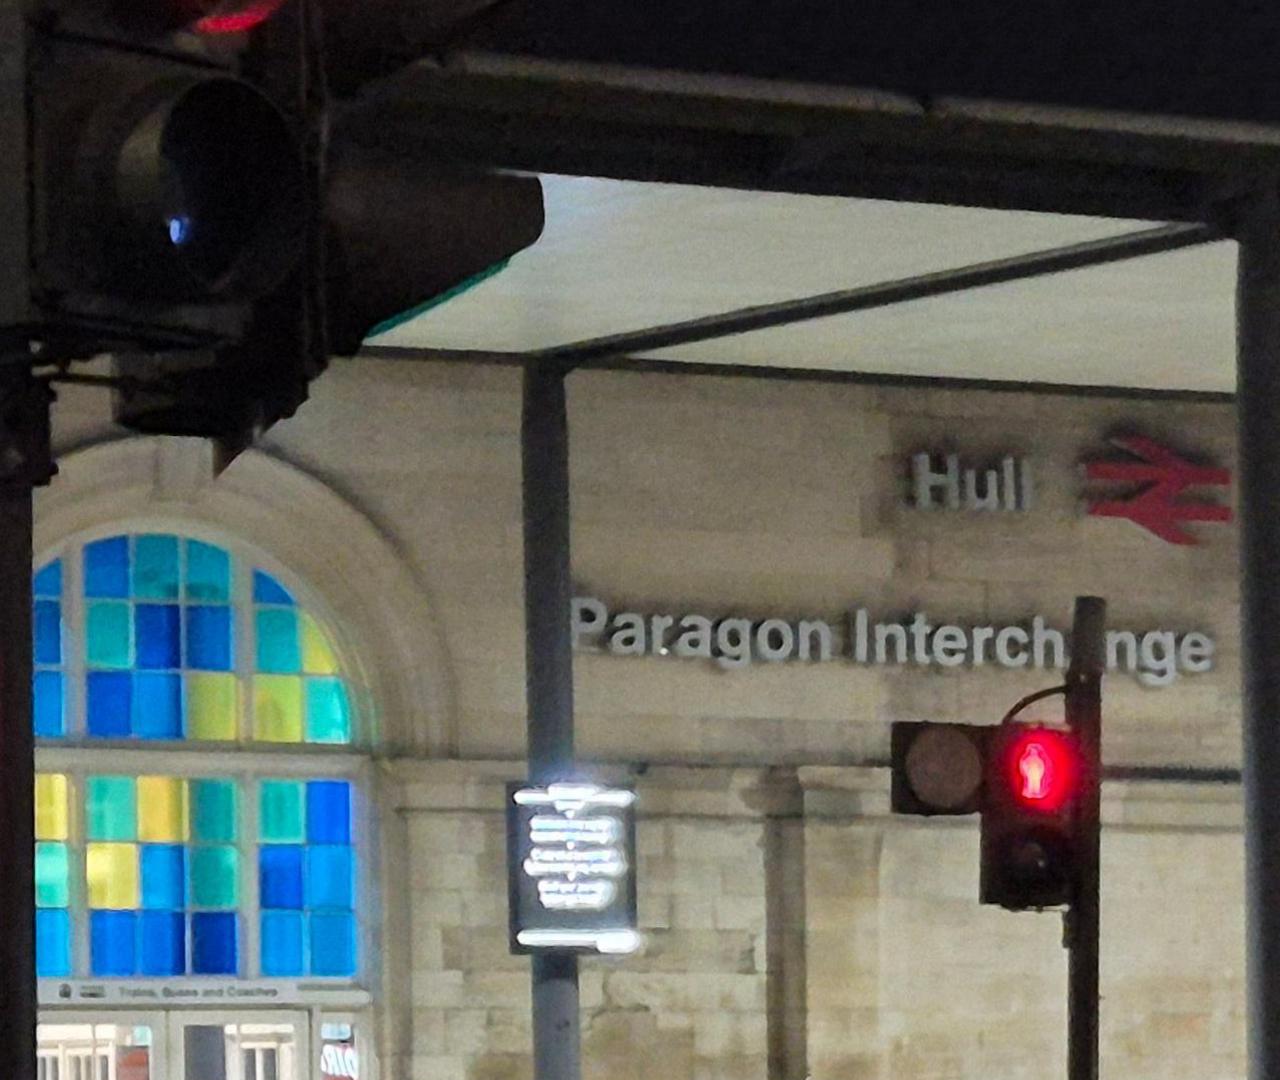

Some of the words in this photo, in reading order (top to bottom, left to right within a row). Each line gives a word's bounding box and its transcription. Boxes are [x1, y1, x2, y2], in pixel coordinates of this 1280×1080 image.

[913, 452, 1031, 512] Hull
[570, 597, 832, 669] Paragon
[855, 608, 1213, 686] Interchnge
